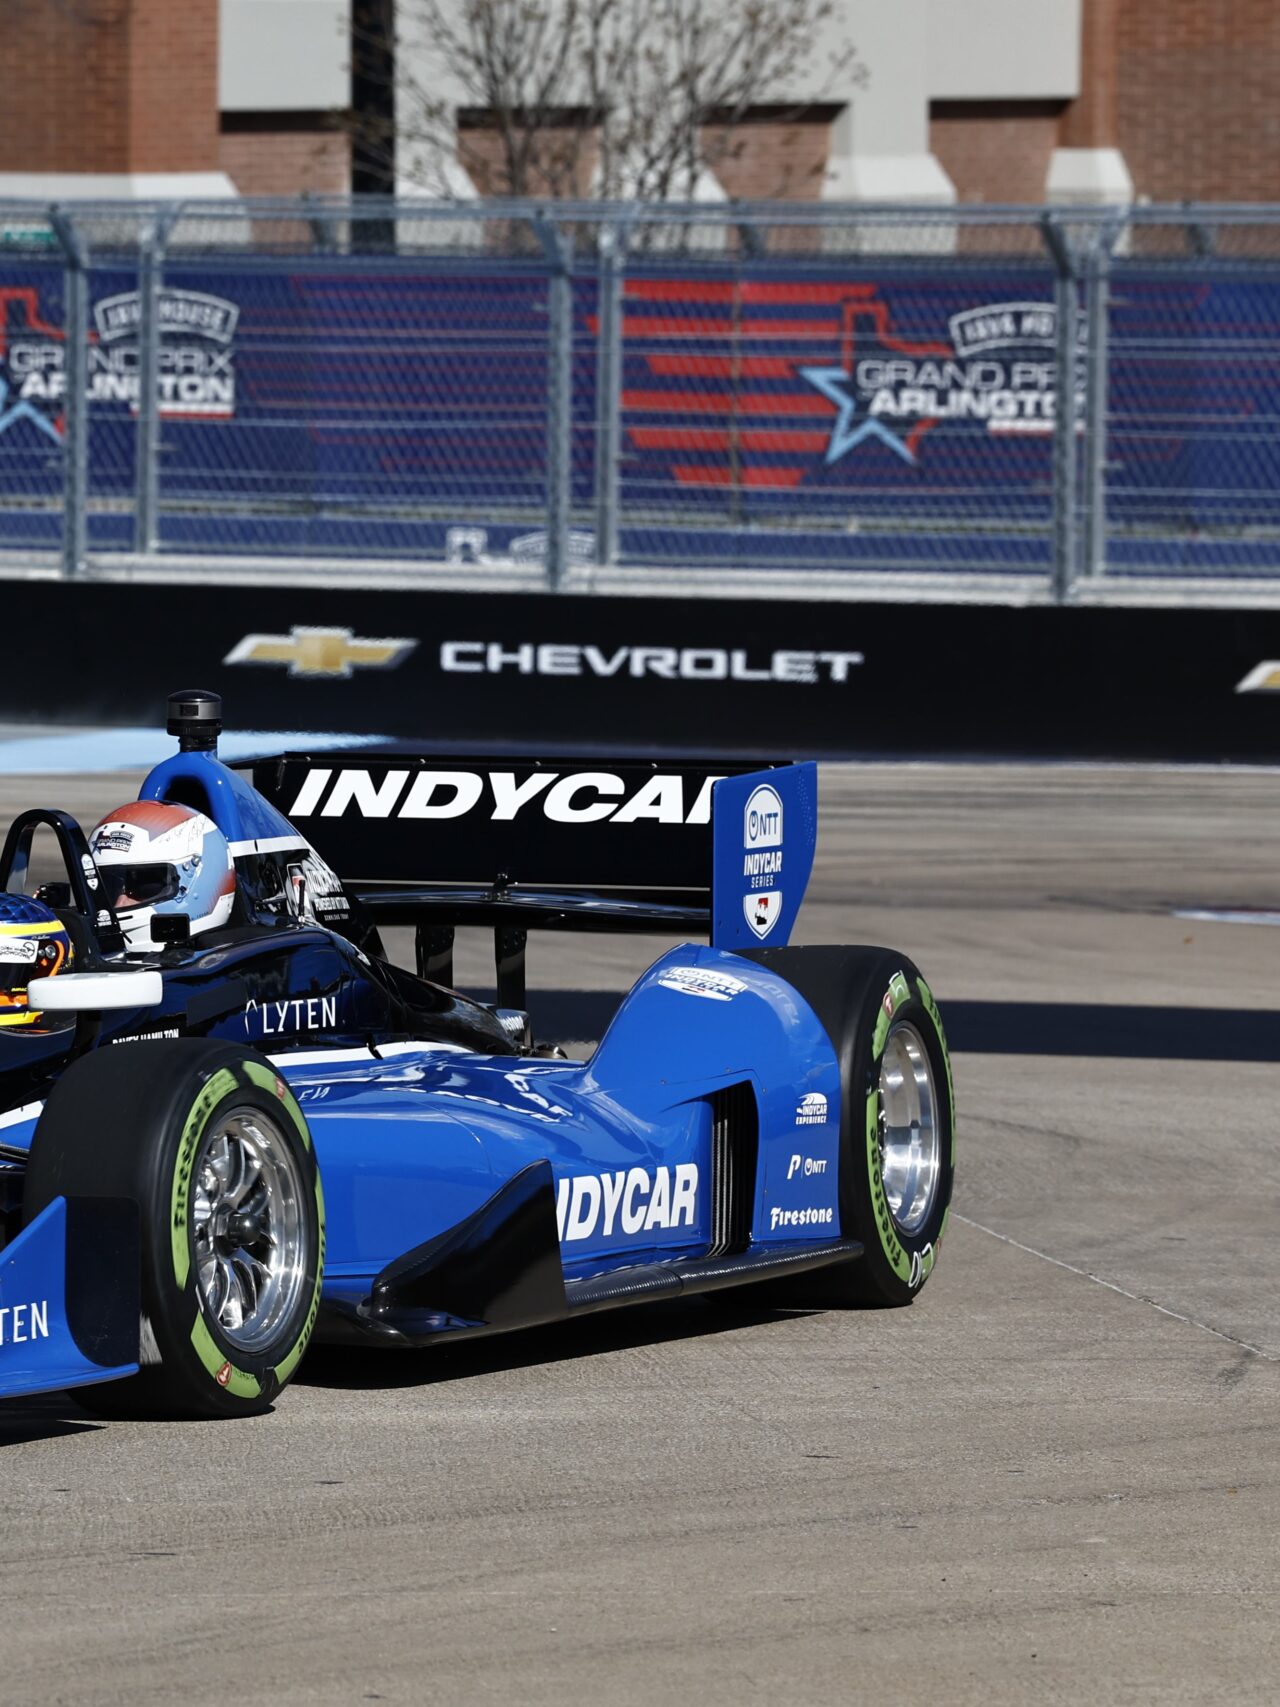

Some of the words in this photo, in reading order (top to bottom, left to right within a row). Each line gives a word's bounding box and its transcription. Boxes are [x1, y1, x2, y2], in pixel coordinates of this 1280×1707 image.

[106, 302, 141, 327] JAV
[158, 299, 224, 327] HOUSE
[9, 343, 142, 374] GRND
[154, 346, 235, 376] PRIX
[20, 373, 235, 401] ARINTON
[857, 359, 1005, 392] GRAND
[1010, 362, 1088, 392] PRX
[439, 641, 864, 683] CHEVROLET
[759, 812, 778, 836] NTT
[744, 851, 783, 876] INDYCAR
[751, 875, 775, 888] SERIES
[262, 996, 336, 1034] LYTEN
[795, 1115, 827, 1125] EXPERIENCE
[802, 1104, 828, 1116] INDYCAR
[812, 1160, 827, 1174] NTT
[556, 1163, 699, 1242] DYCAR
[770, 1206, 833, 1231] Firestone
